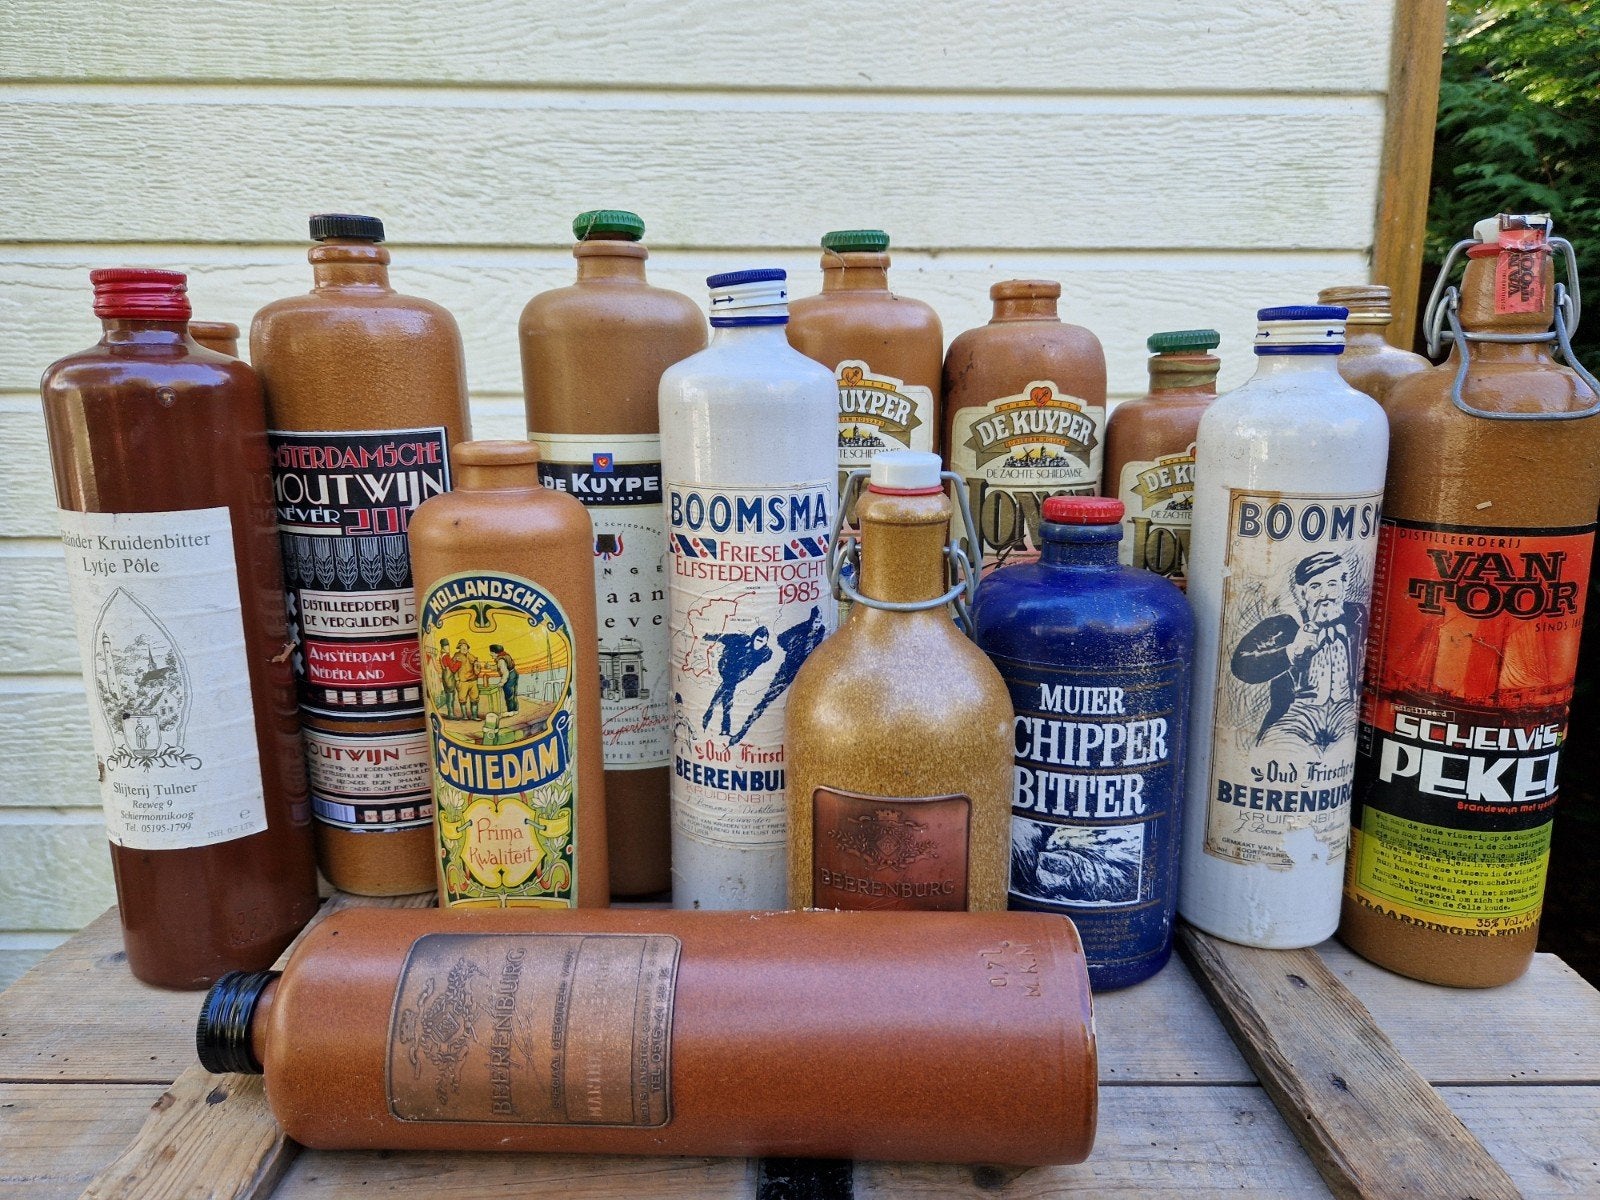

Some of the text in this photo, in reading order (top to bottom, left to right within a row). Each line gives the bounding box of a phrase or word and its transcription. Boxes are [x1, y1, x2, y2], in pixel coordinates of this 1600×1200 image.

[975, 409, 1094, 447] DE KUYPER
[273, 441, 443, 469] STERDAMSCHE
[853, 447, 901, 459] SCHIE
[543, 473, 659, 494] DE KUYPE
[987, 467, 1084, 479] DE ZACHTE SCHIEDAMSE
[1142, 467, 1173, 493] DE
[279, 505, 341, 524] NEVER
[670, 491, 829, 535] BOOMSMA
[1151, 510, 1192, 520] DE ZACHTE
[97, 533, 212, 551] Kruidenbitter
[1400, 529, 1521, 549] DISTILLEERDERIJ
[720, 541, 782, 563] FRIESE
[82, 556, 160, 577] Lytje Pôle
[604, 565, 663, 576] NGE
[676, 554, 826, 582] ELFSTEDENTOCHT
[1426, 549, 1567, 584] VAN
[430, 580, 546, 617] HOLLANDSCHE
[607, 589, 664, 605] aan
[778, 580, 820, 605] 1985
[1408, 577, 1578, 621] TOOR
[303, 598, 399, 613] DISTILLEERDERIJ
[305, 614, 318, 627] DE
[321, 614, 399, 628] VERGULDEN
[1535, 621, 1568, 632] SINDS
[1039, 683, 1126, 715] MUIER
[1014, 715, 1168, 767] CHIPPER
[310, 742, 400, 766] OUTWIJN
[438, 736, 559, 790] SCHIEDAM
[676, 754, 786, 792] BEERENBU
[1379, 737, 1559, 802] PEKEL
[113, 781, 197, 798] Slijterij Tulner
[686, 783, 786, 804] KRUIDENBITT
[1012, 765, 1147, 818] BITTER
[132, 799, 173, 810] Reeweg 9
[1457, 800, 1518, 815] Brandewijn
[1520, 803, 1537, 812] met
[120, 810, 194, 821] Schiermonnikoog
[125, 821, 192, 833] Tel. 05195-1799
[477, 817, 523, 845] Prima
[1407, 822, 1418, 831] de
[1421, 827, 1444, 836] oude
[1447, 831, 1487, 843] visserij
[1221, 836, 1256, 849] GEMAAKT
[1237, 847, 1290, 859] KOORTSWEREN
[1486, 843, 1497, 851] de
[469, 846, 535, 872] Kwaliteit
[820, 867, 955, 898] BEERENBURG
[1502, 870, 1513, 878] de
[1481, 889, 1498, 897] het
[1355, 892, 1489, 938] VLAARDINGEN
[1496, 920, 1539, 937] HOLLA
[1442, 901, 1454, 909] de
[1456, 901, 1482, 911] felle
[1475, 916, 1523, 929] 35% Vol.
[986, 961, 1009, 988] 0,7
[492, 947, 527, 1116] BEERENBURG
[551, 1054, 562, 1109] SPECIAAL
[650, 1065, 663, 1093] TEL
